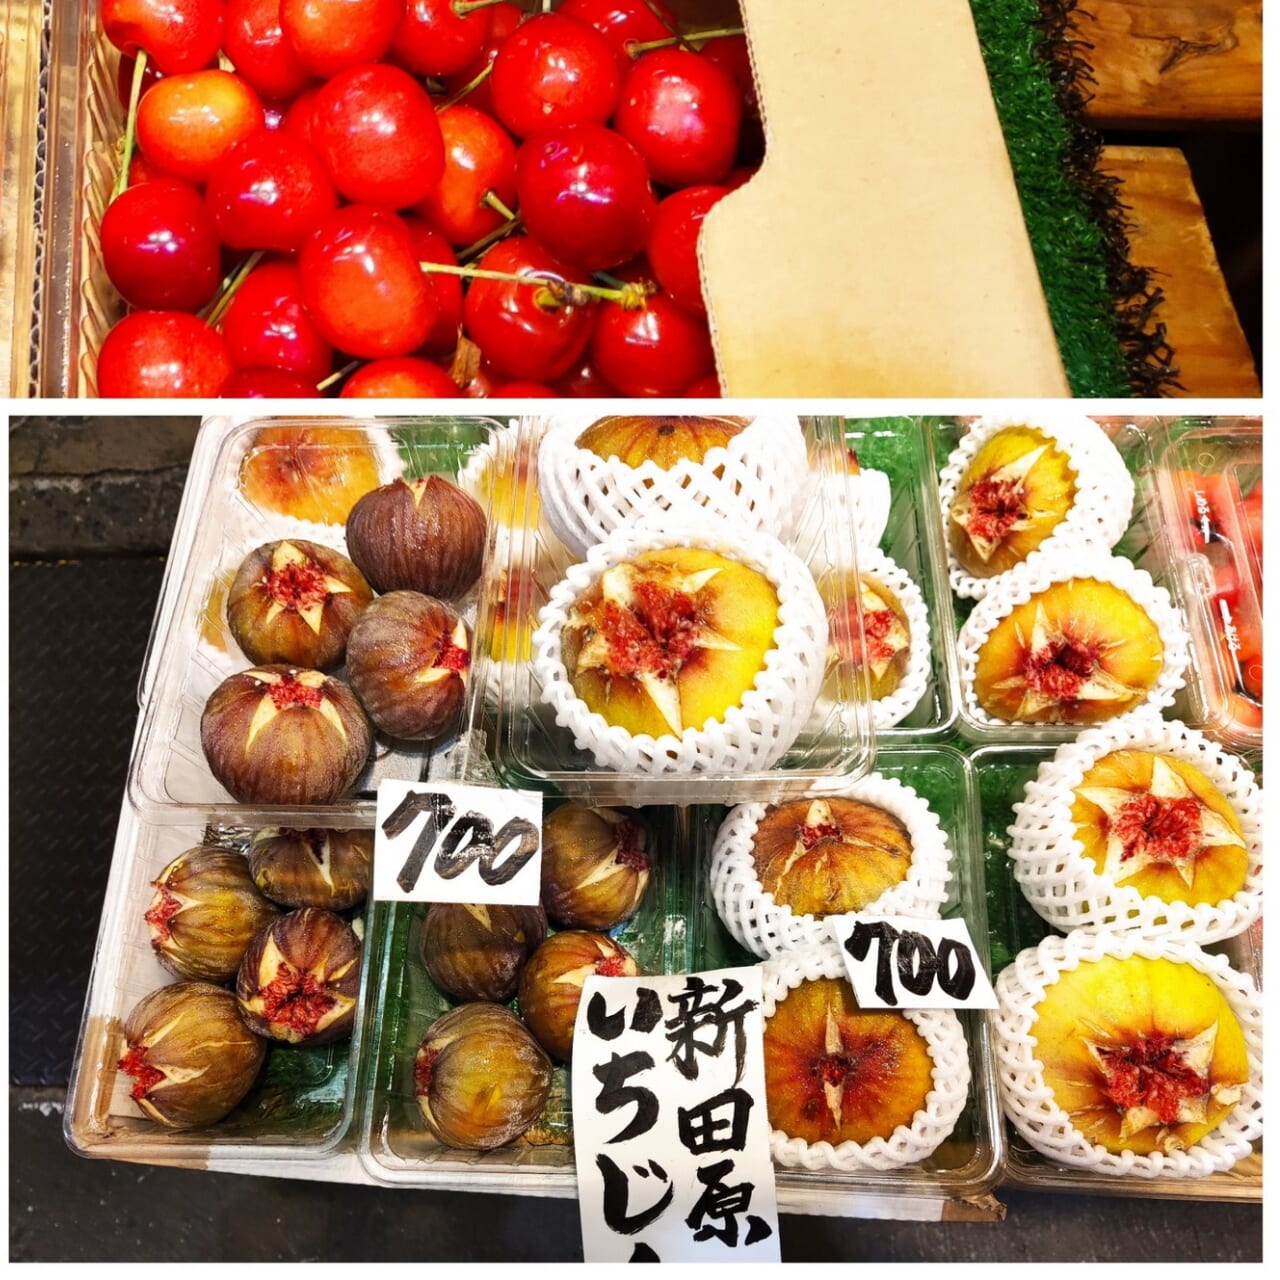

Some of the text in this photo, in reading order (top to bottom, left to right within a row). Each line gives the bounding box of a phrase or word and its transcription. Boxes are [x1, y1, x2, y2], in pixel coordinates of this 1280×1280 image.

[381, 790, 540, 894] 700
[843, 920, 976, 1005] 700
[586, 985, 675, 1263] いちじ
[664, 976, 773, 1248] 新田原
